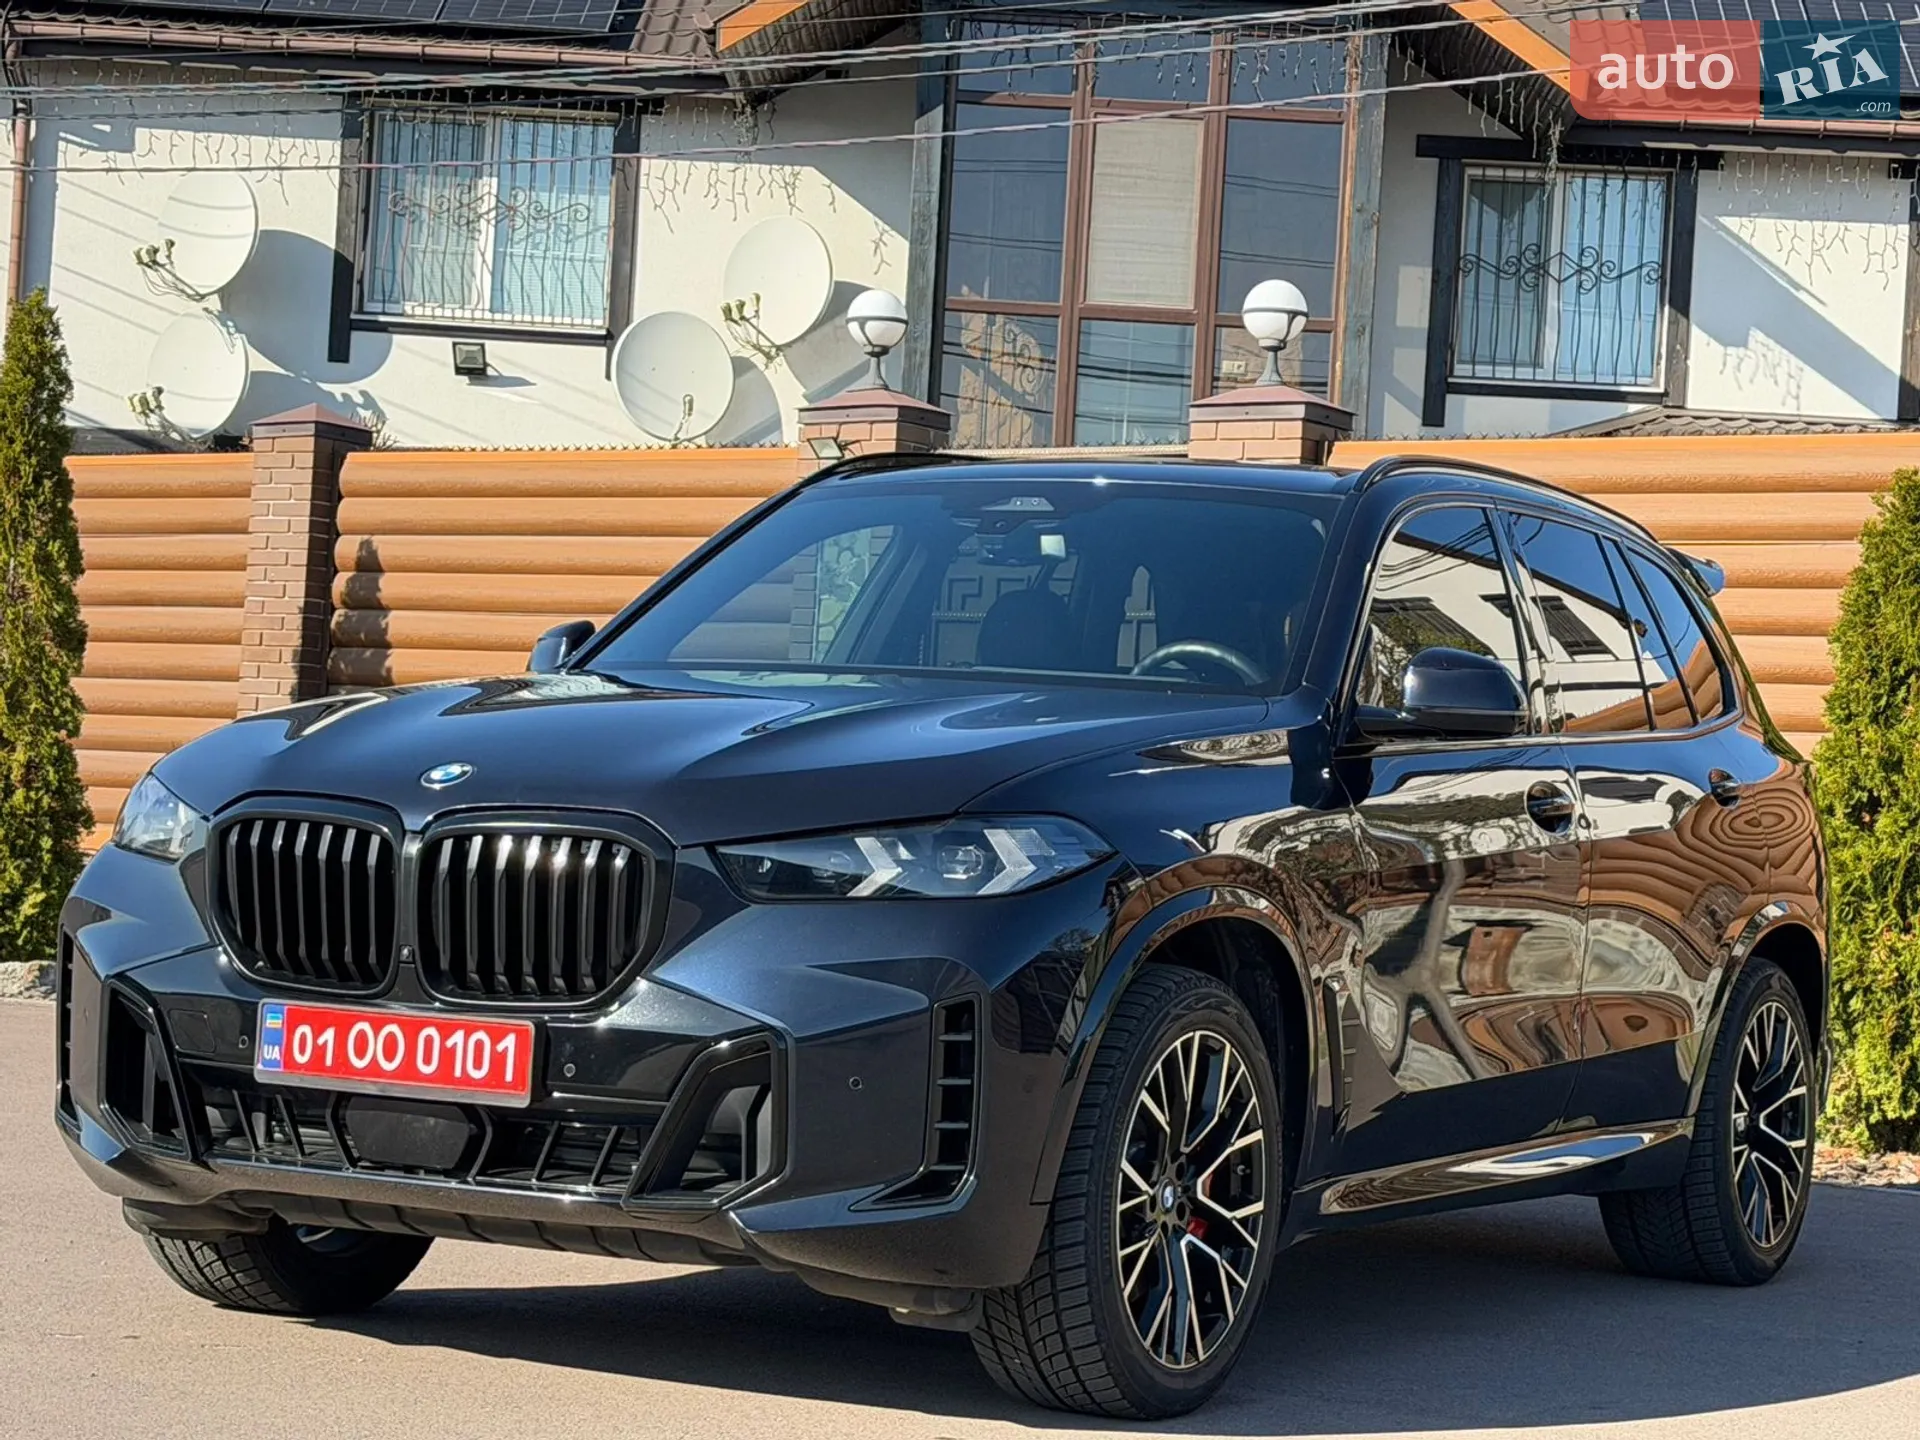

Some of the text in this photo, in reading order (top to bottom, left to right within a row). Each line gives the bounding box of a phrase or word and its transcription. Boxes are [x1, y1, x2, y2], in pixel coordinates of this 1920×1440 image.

[263, 1044, 281, 1061] UA
[292, 1024, 336, 1067] 01
[416, 1026, 517, 1083] 0101
